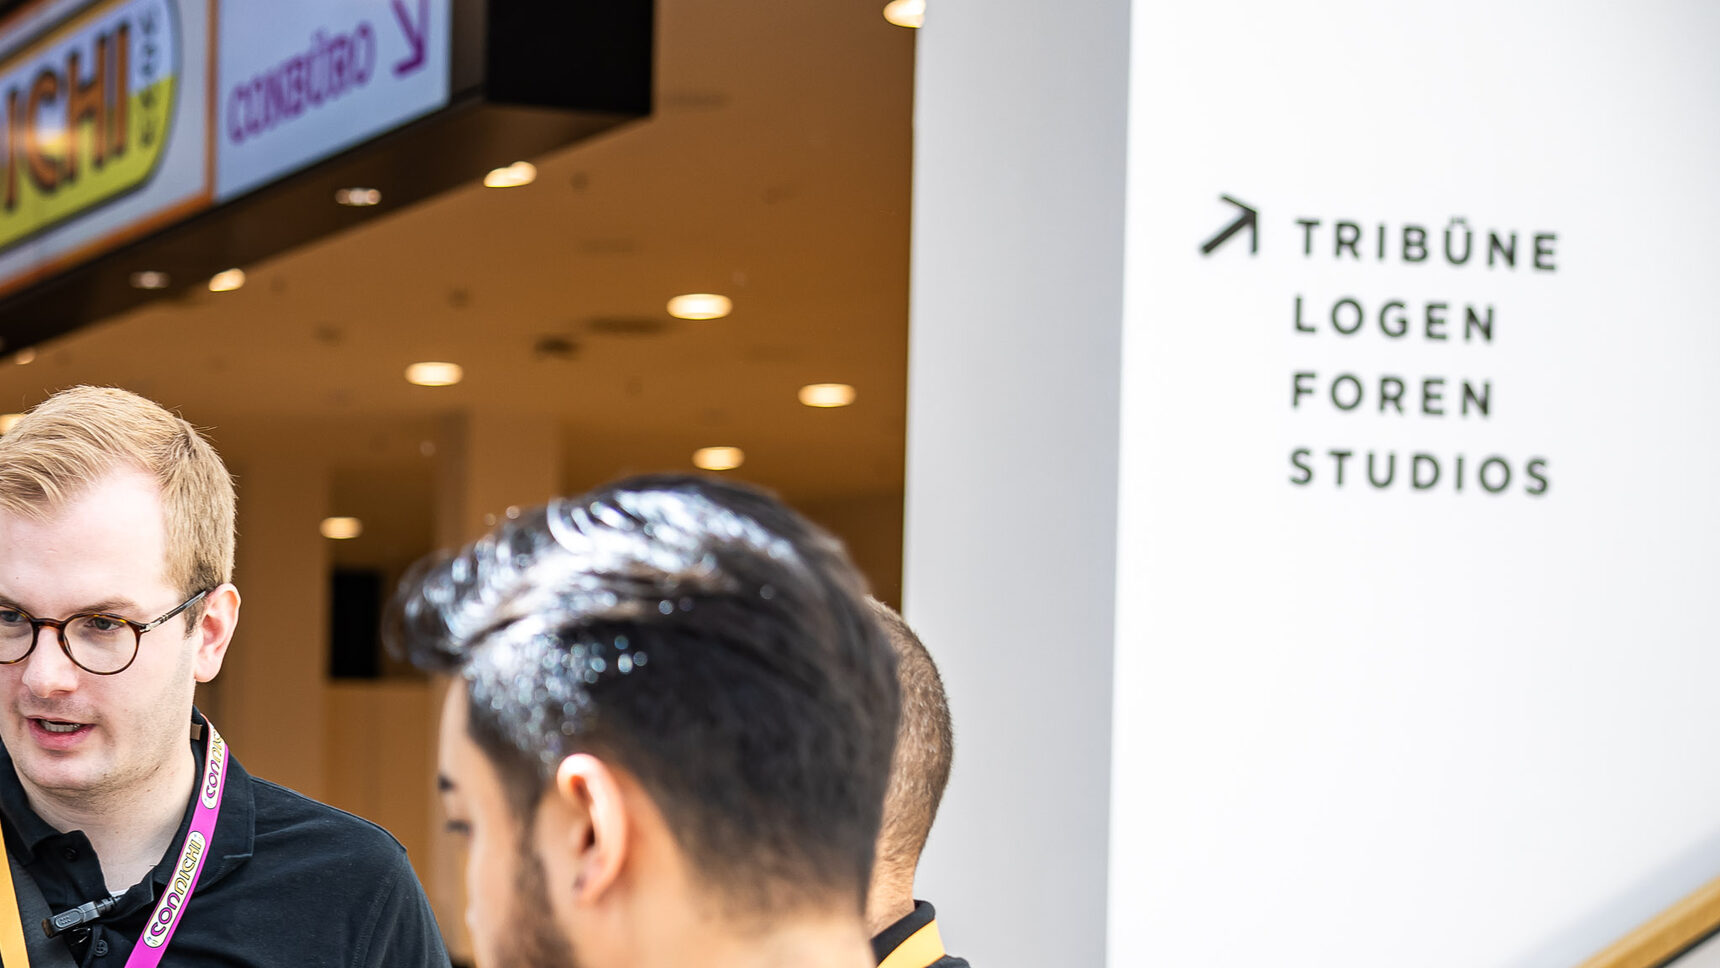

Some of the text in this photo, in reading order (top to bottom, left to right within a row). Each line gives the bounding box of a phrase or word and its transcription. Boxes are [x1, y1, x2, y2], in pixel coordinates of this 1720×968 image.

[1295, 217, 1560, 273] TRIBÜNE
[1294, 294, 1495, 343] LOGEN
[1291, 371, 1492, 418] FOREN
[1289, 447, 1551, 497] STUDIOS
[151, 838, 202, 938] CONNICHI
